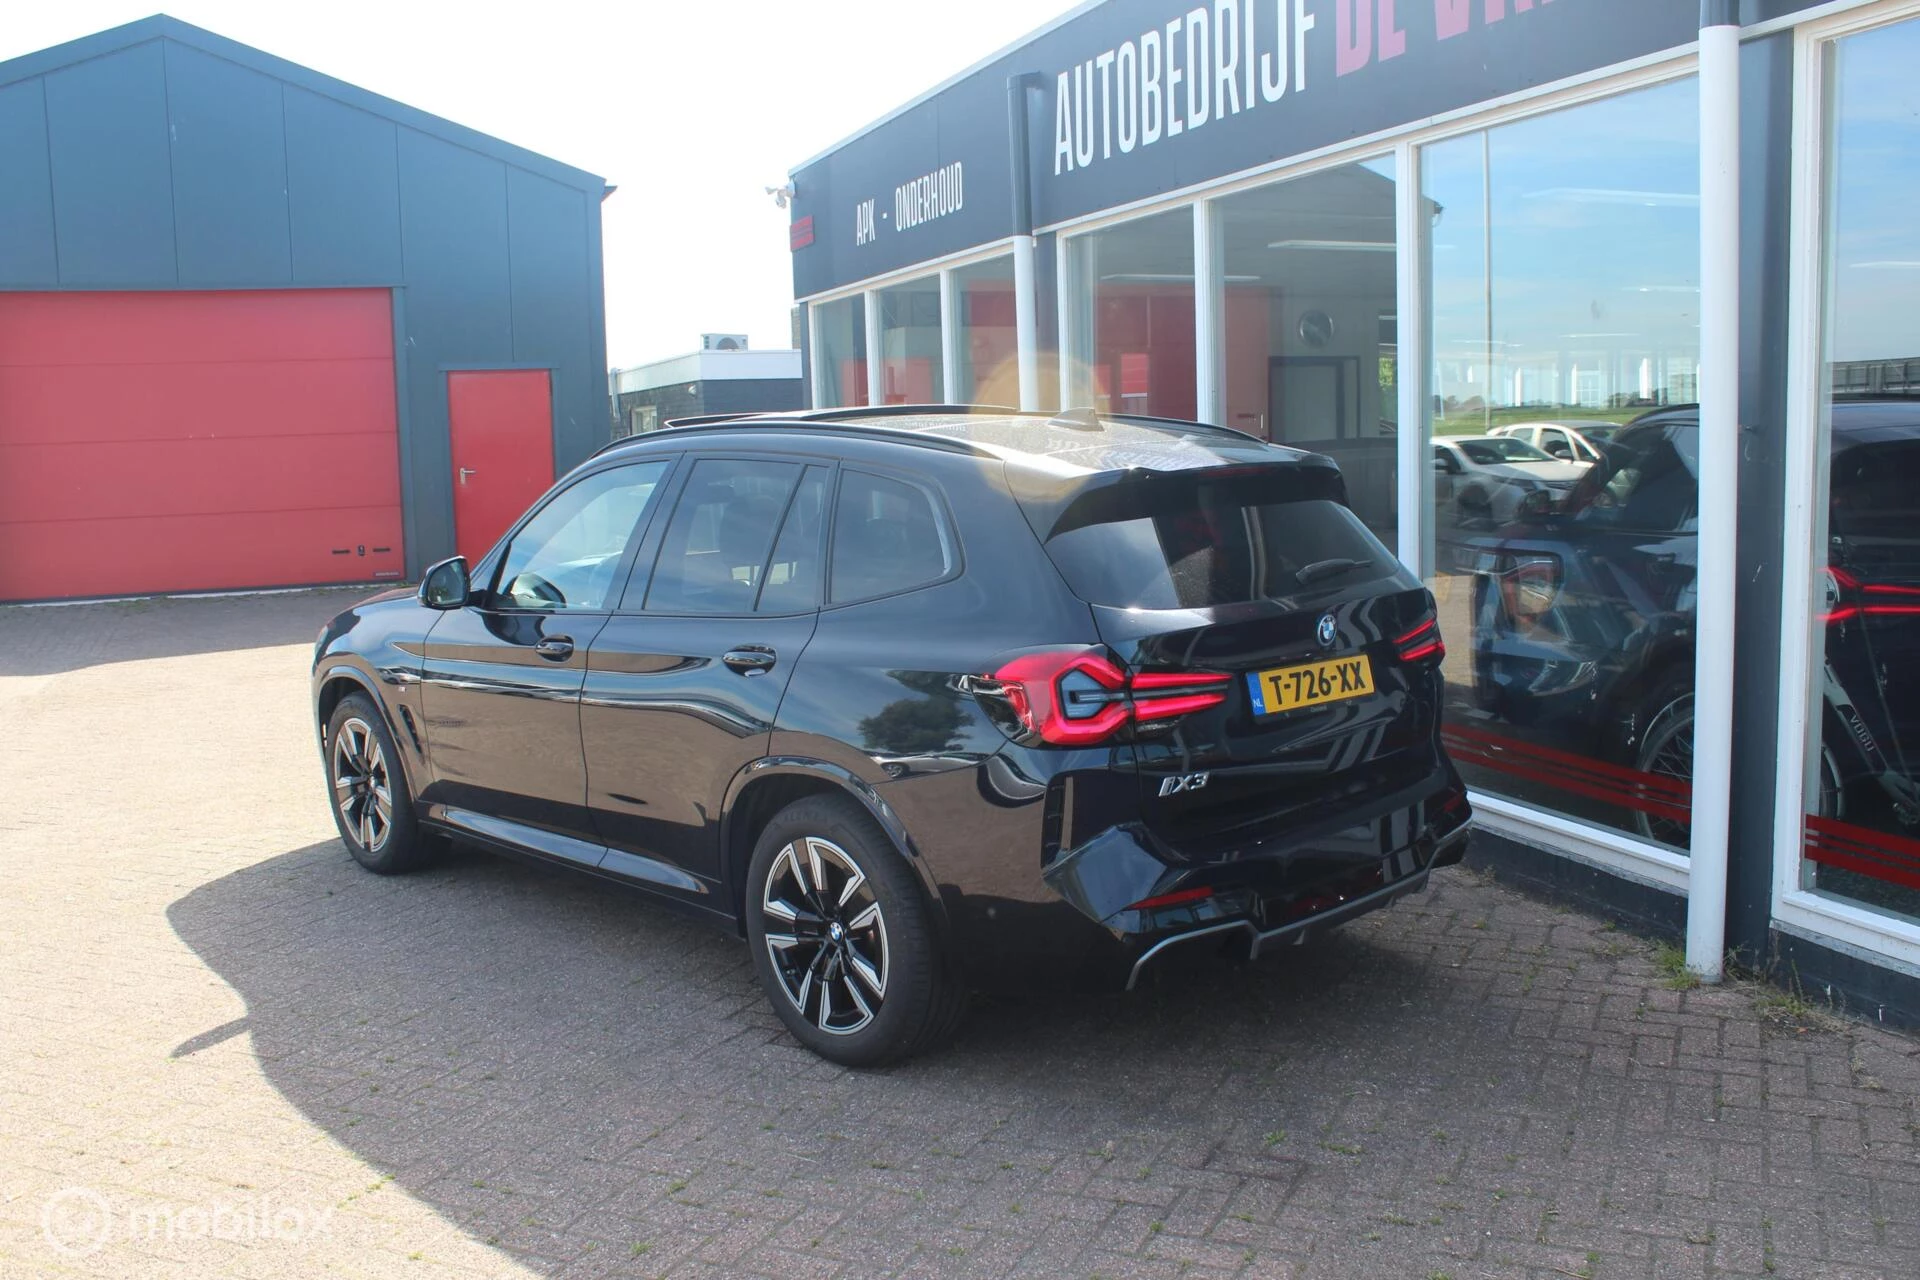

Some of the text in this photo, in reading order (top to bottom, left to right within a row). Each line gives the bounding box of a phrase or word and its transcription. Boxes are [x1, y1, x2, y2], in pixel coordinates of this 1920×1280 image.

[1054, 0, 1315, 176] AUTOBEDRIJF
[856, 199, 876, 246] APK
[895, 161, 963, 232] ONDERHOUD
[1268, 662, 1366, 705] T-726-XX
